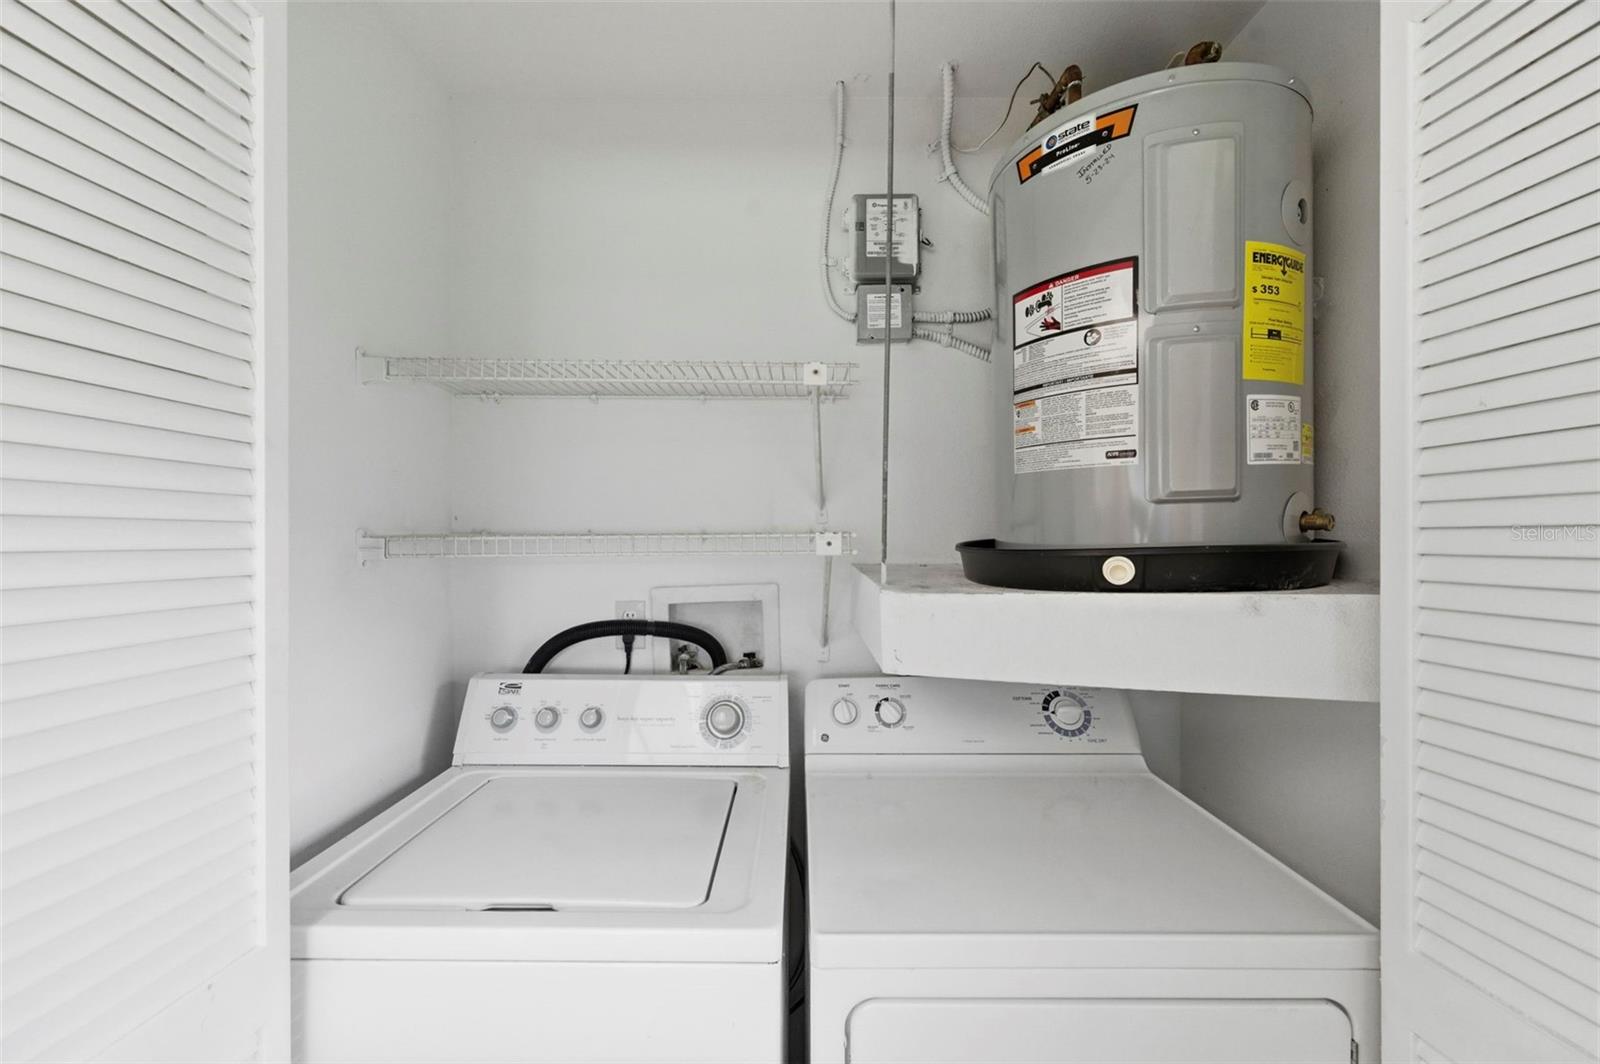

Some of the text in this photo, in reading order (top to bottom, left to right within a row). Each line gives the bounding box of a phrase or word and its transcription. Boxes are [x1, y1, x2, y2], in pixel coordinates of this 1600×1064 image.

[1057, 120, 1091, 140] state
[1055, 143, 1078, 157] ProLine
[1252, 251, 1304, 274] ENERGYGUIDE
[1054, 274, 1080, 287] DANGER
[1260, 284, 1280, 295] 353
